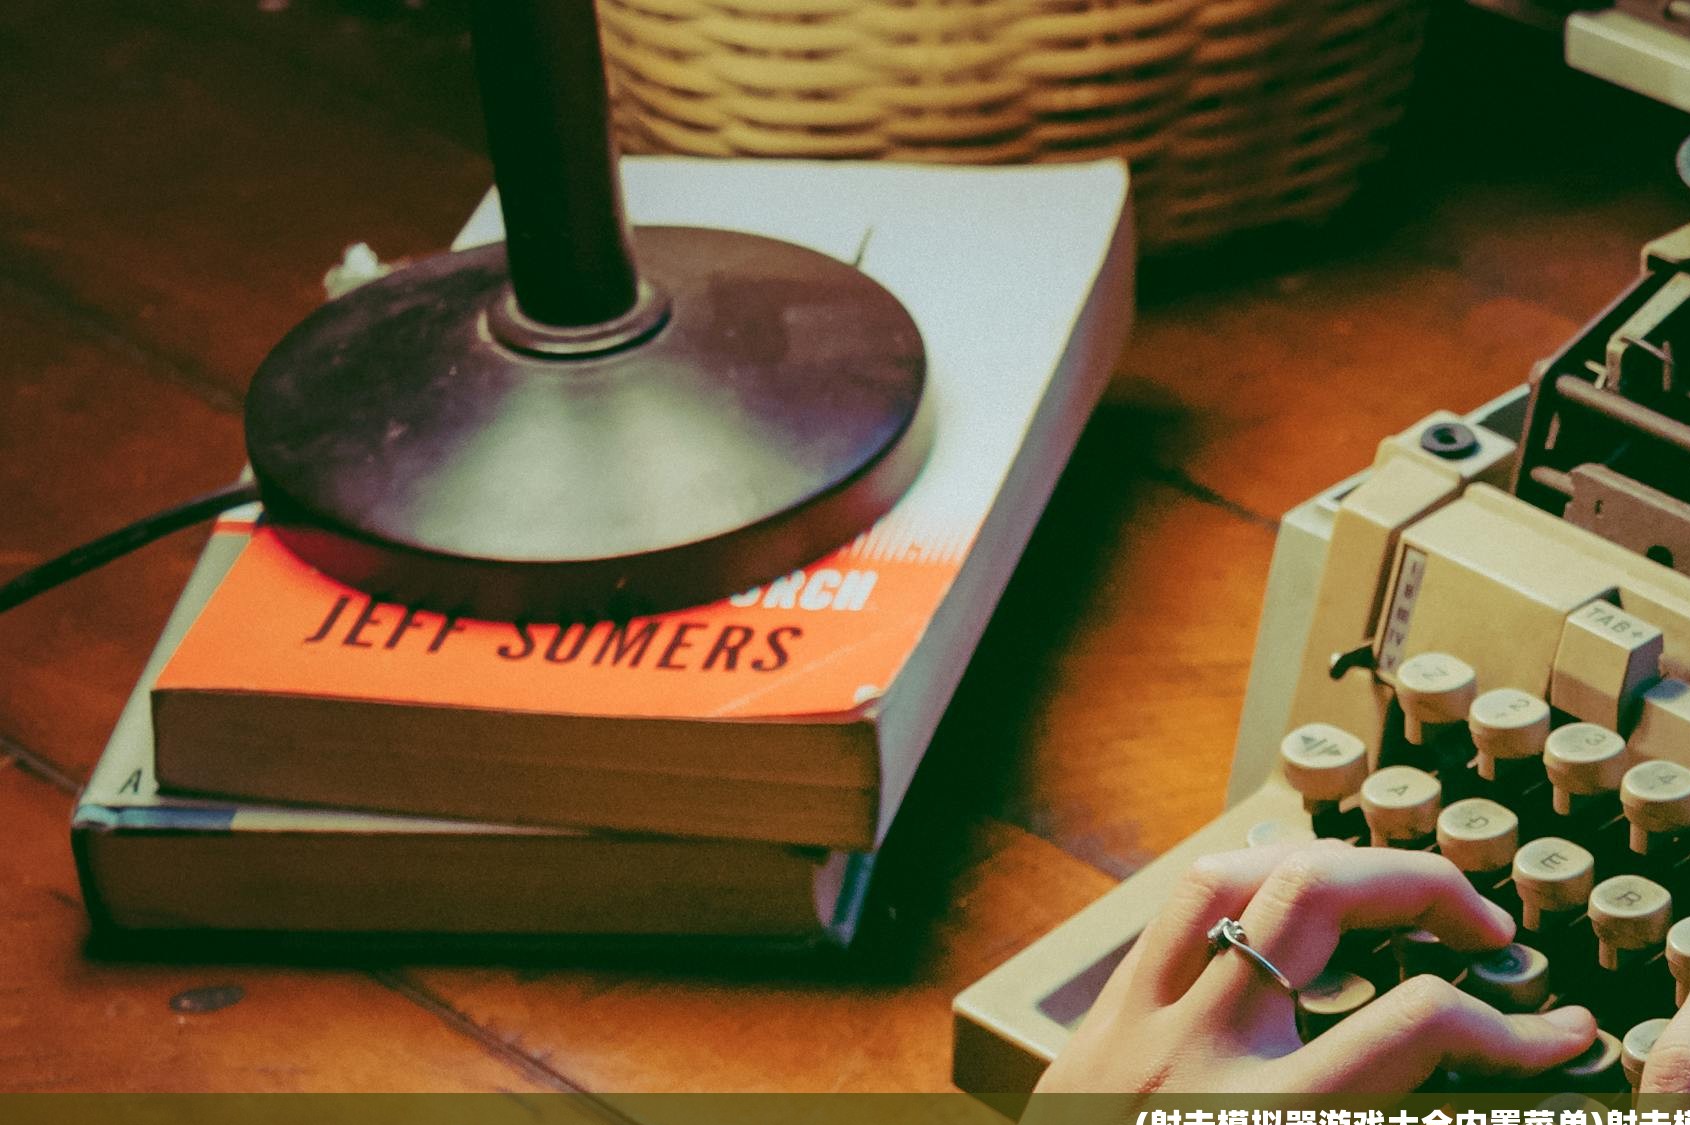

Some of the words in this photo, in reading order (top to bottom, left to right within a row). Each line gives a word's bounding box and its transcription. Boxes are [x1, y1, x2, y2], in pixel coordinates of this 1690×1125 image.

[304, 594, 466, 655] JEFF
[497, 618, 804, 673] SOMERS
[1542, 853, 1568, 870] E
[1616, 891, 1642, 906] R
